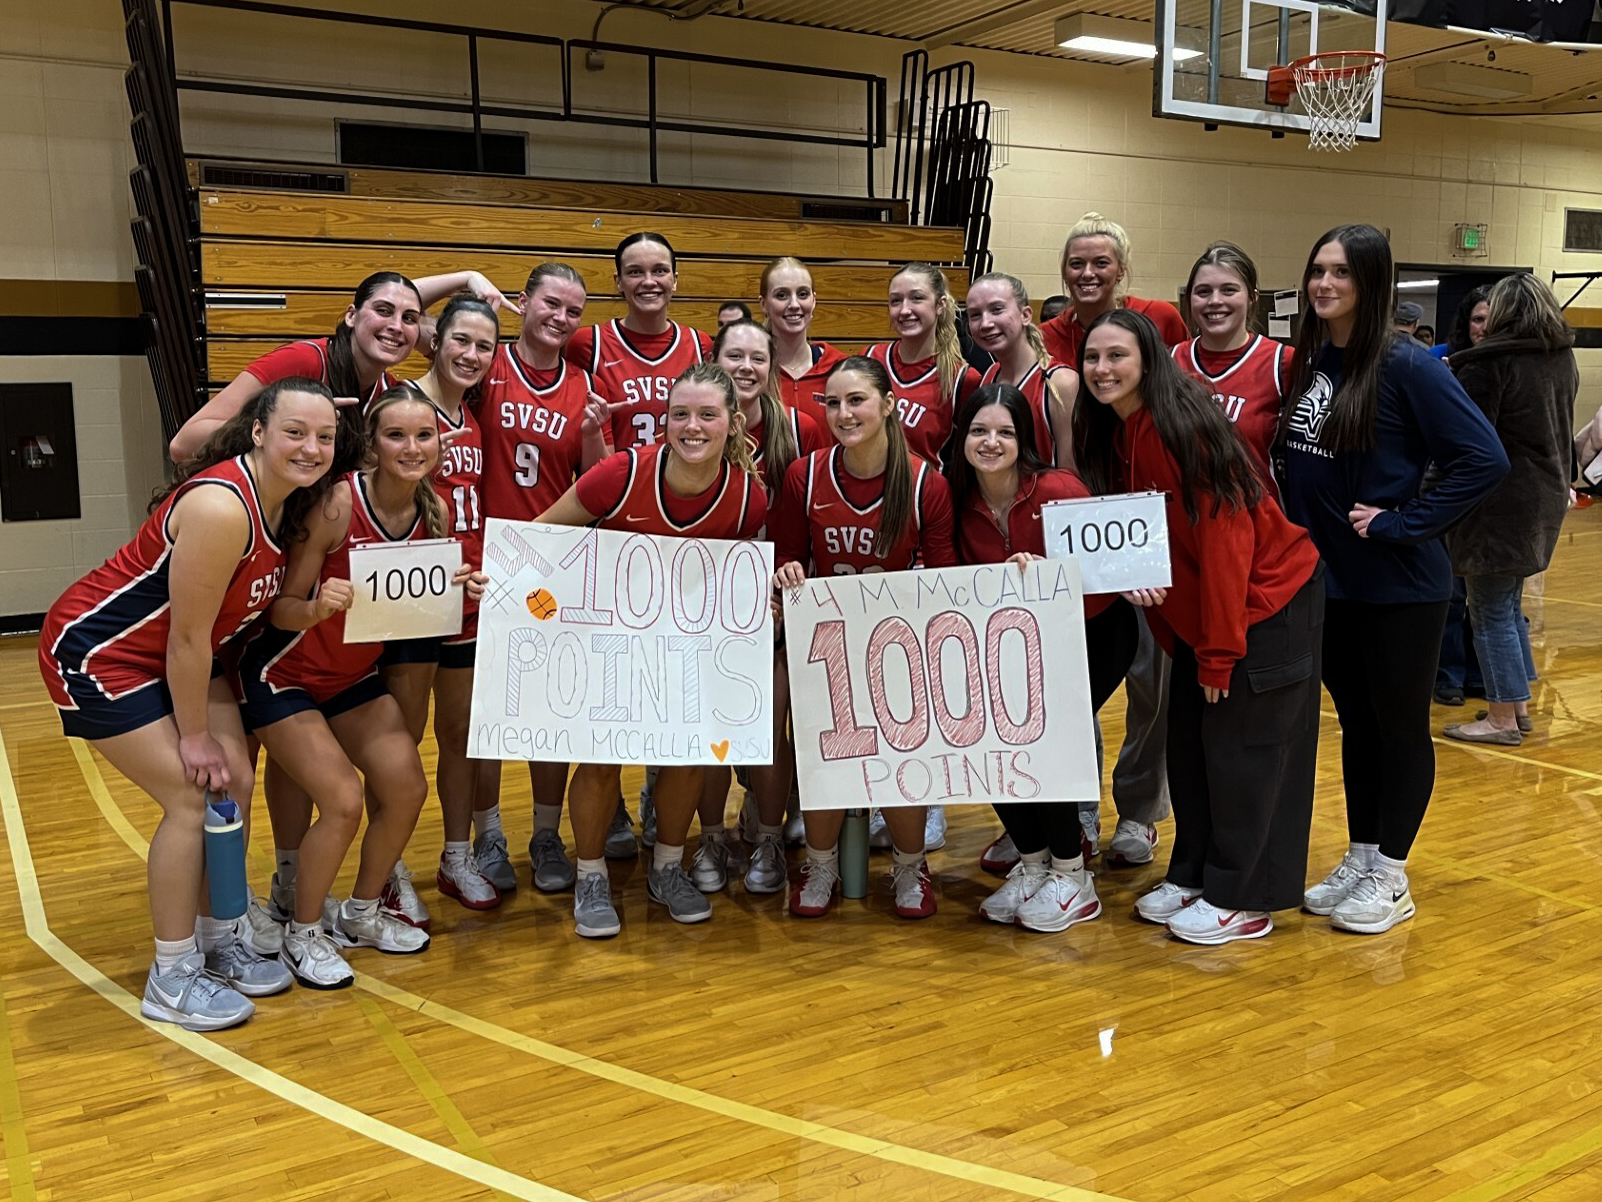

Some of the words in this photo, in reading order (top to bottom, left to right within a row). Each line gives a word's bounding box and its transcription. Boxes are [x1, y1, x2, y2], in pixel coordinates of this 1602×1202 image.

[623, 376, 677, 404] SVS
[501, 401, 568, 440] SVSU
[632, 413, 667, 447] 3
[514, 442, 540, 488] 9
[452, 484, 480, 532] 11
[1060, 518, 1149, 554] 1000
[366, 564, 446, 602] 1000
[559, 527, 769, 635] 1000
[505, 627, 763, 726] POINTS
[807, 605, 1046, 761] 1000
[477, 723, 573, 760] Megan
[861, 750, 1042, 803] POINTS
